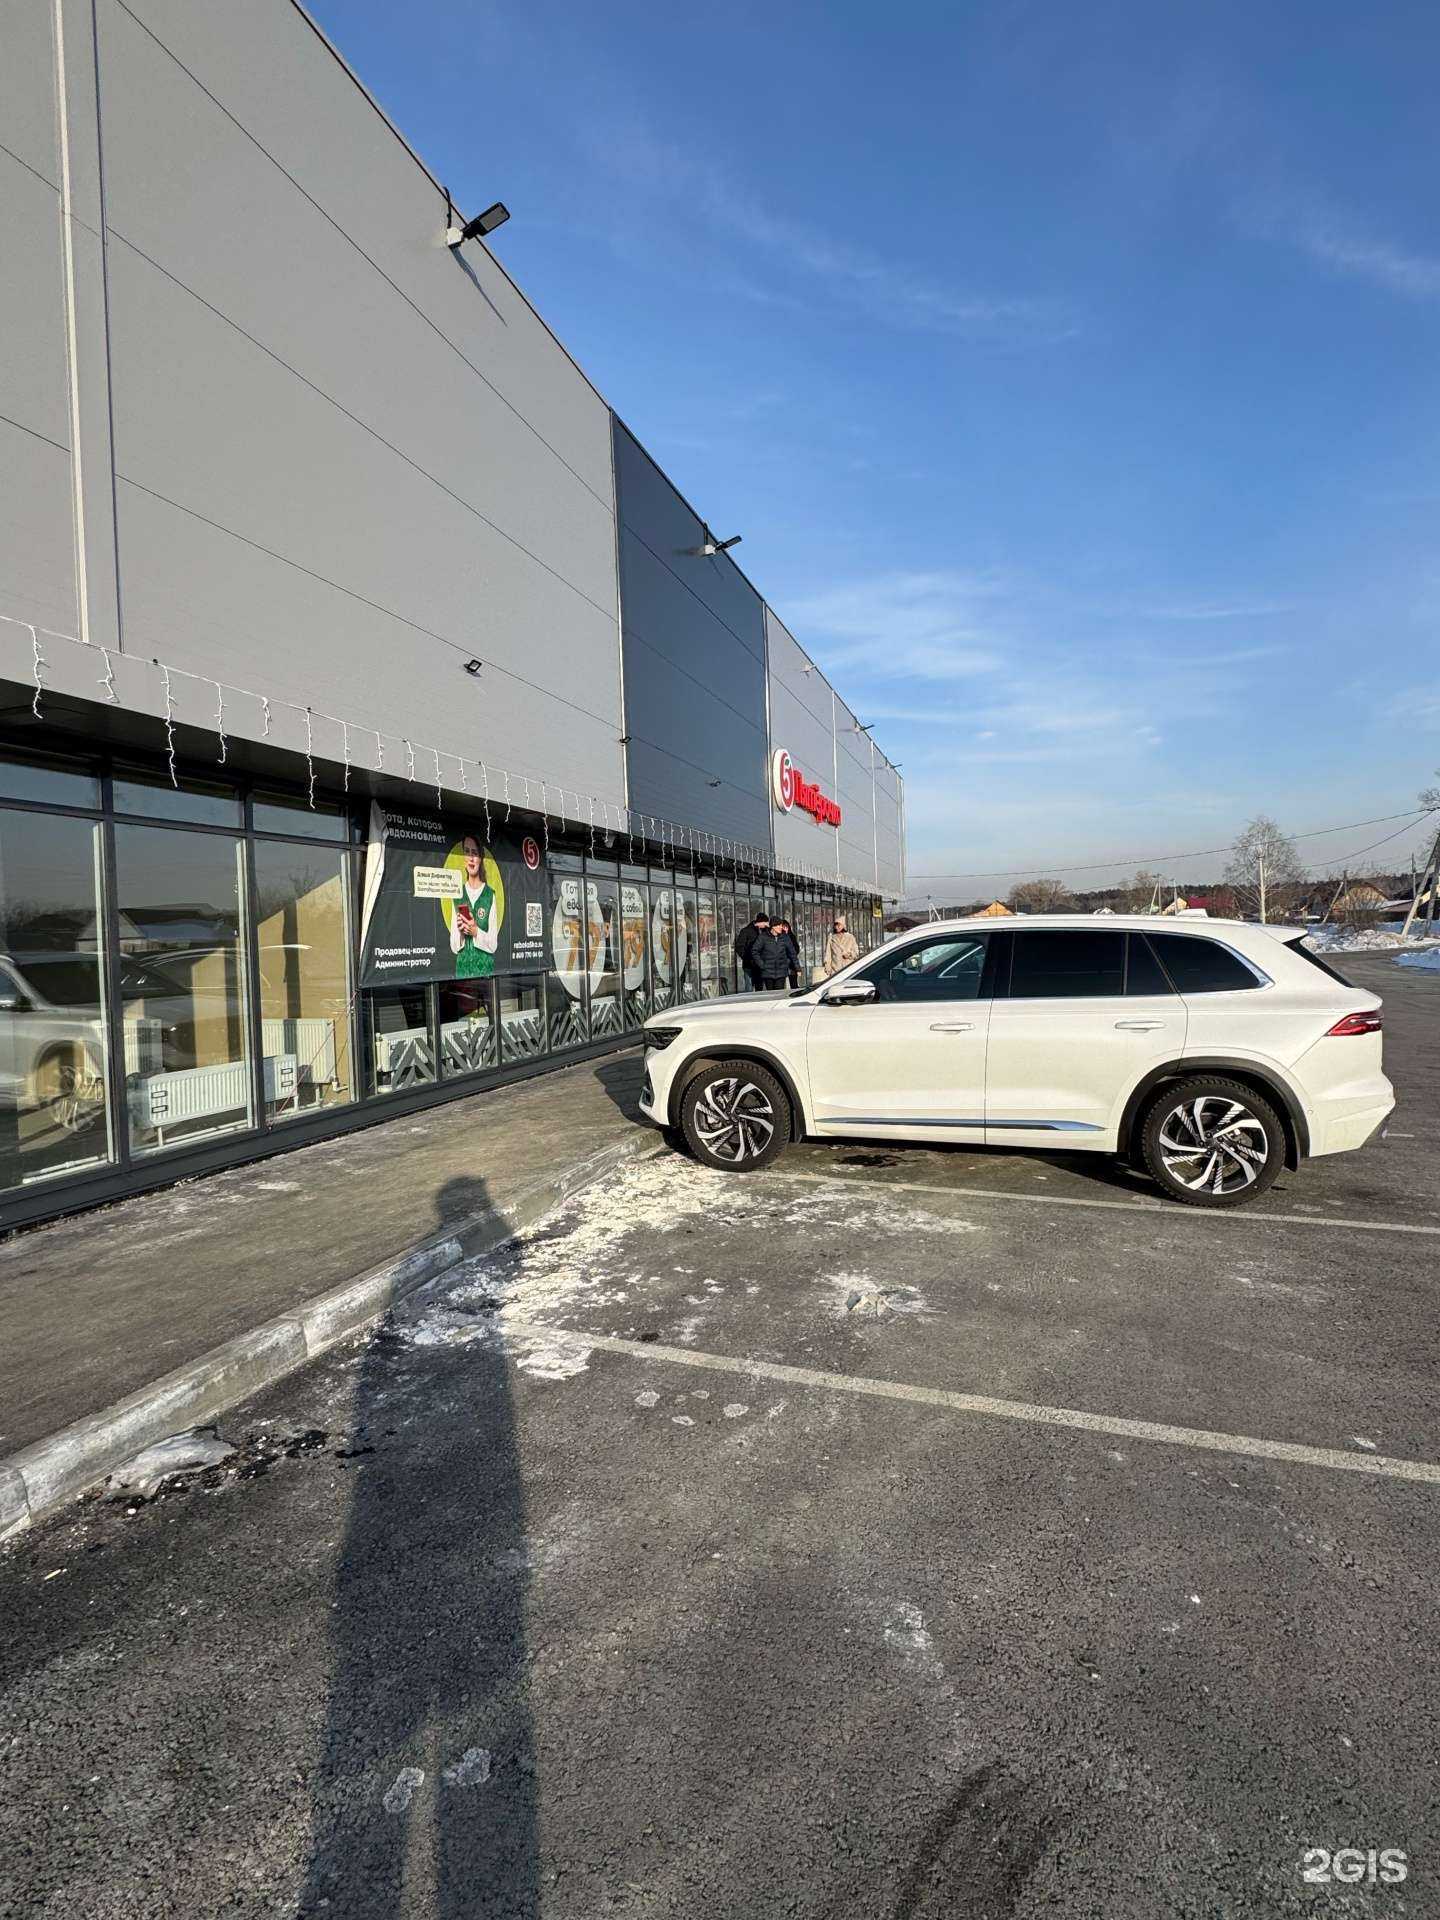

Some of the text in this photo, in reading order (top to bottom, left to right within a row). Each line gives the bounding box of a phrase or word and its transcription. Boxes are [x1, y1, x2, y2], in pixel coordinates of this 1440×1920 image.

[408, 817, 443, 831] которая
[389, 828, 446, 843] вдохновляет
[375, 946, 436, 958] Продавец-кассир
[375, 958, 431, 970] Администратор
